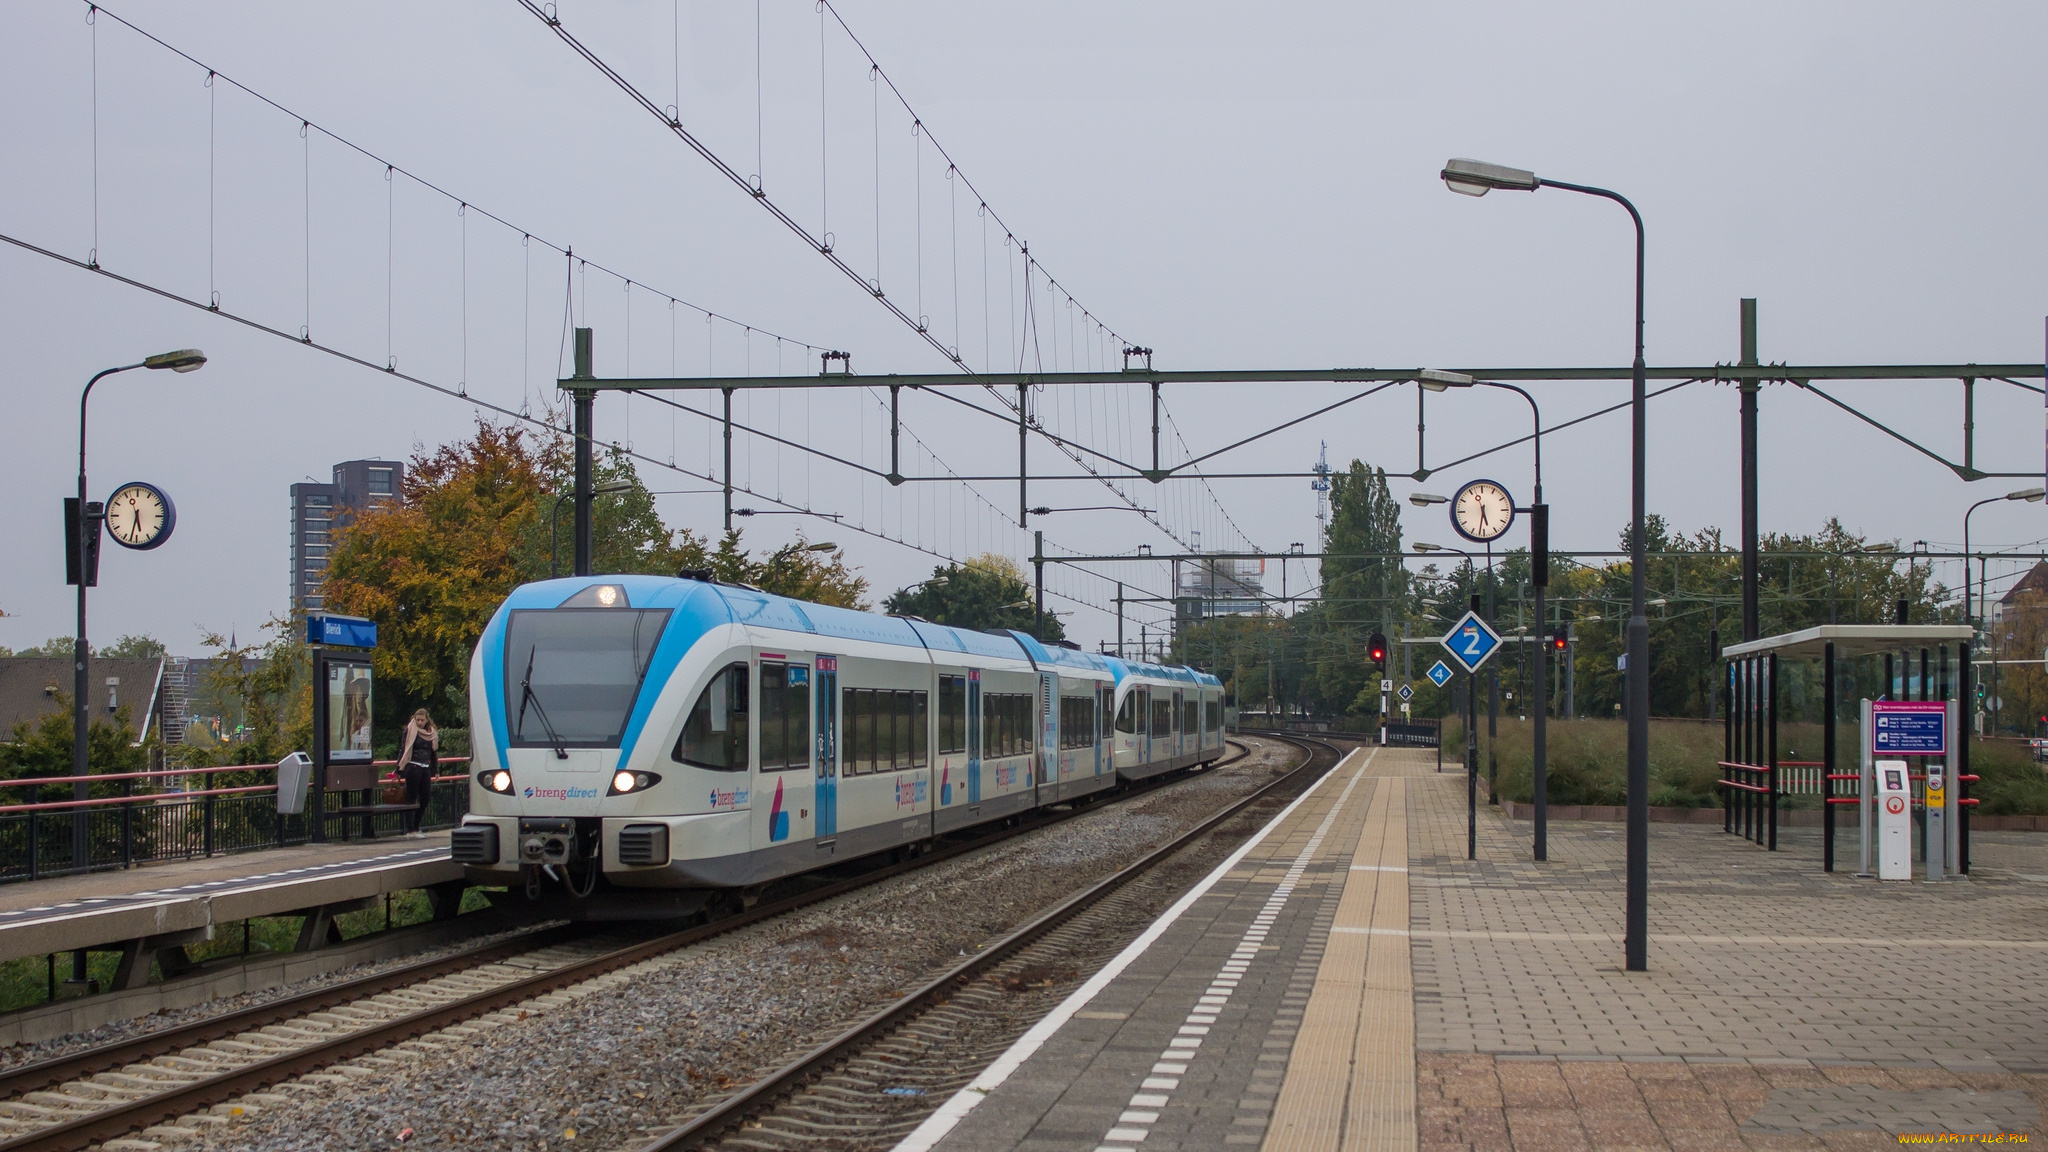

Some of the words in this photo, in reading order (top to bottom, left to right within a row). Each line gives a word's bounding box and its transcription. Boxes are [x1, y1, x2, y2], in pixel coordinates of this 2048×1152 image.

[1463, 632, 1480, 655] 2
[1435, 669, 1444, 679] 4
[1383, 681, 1390, 691] 4
[535, 786, 598, 800] brengdirect
[717, 786, 749, 809] brengdirect
